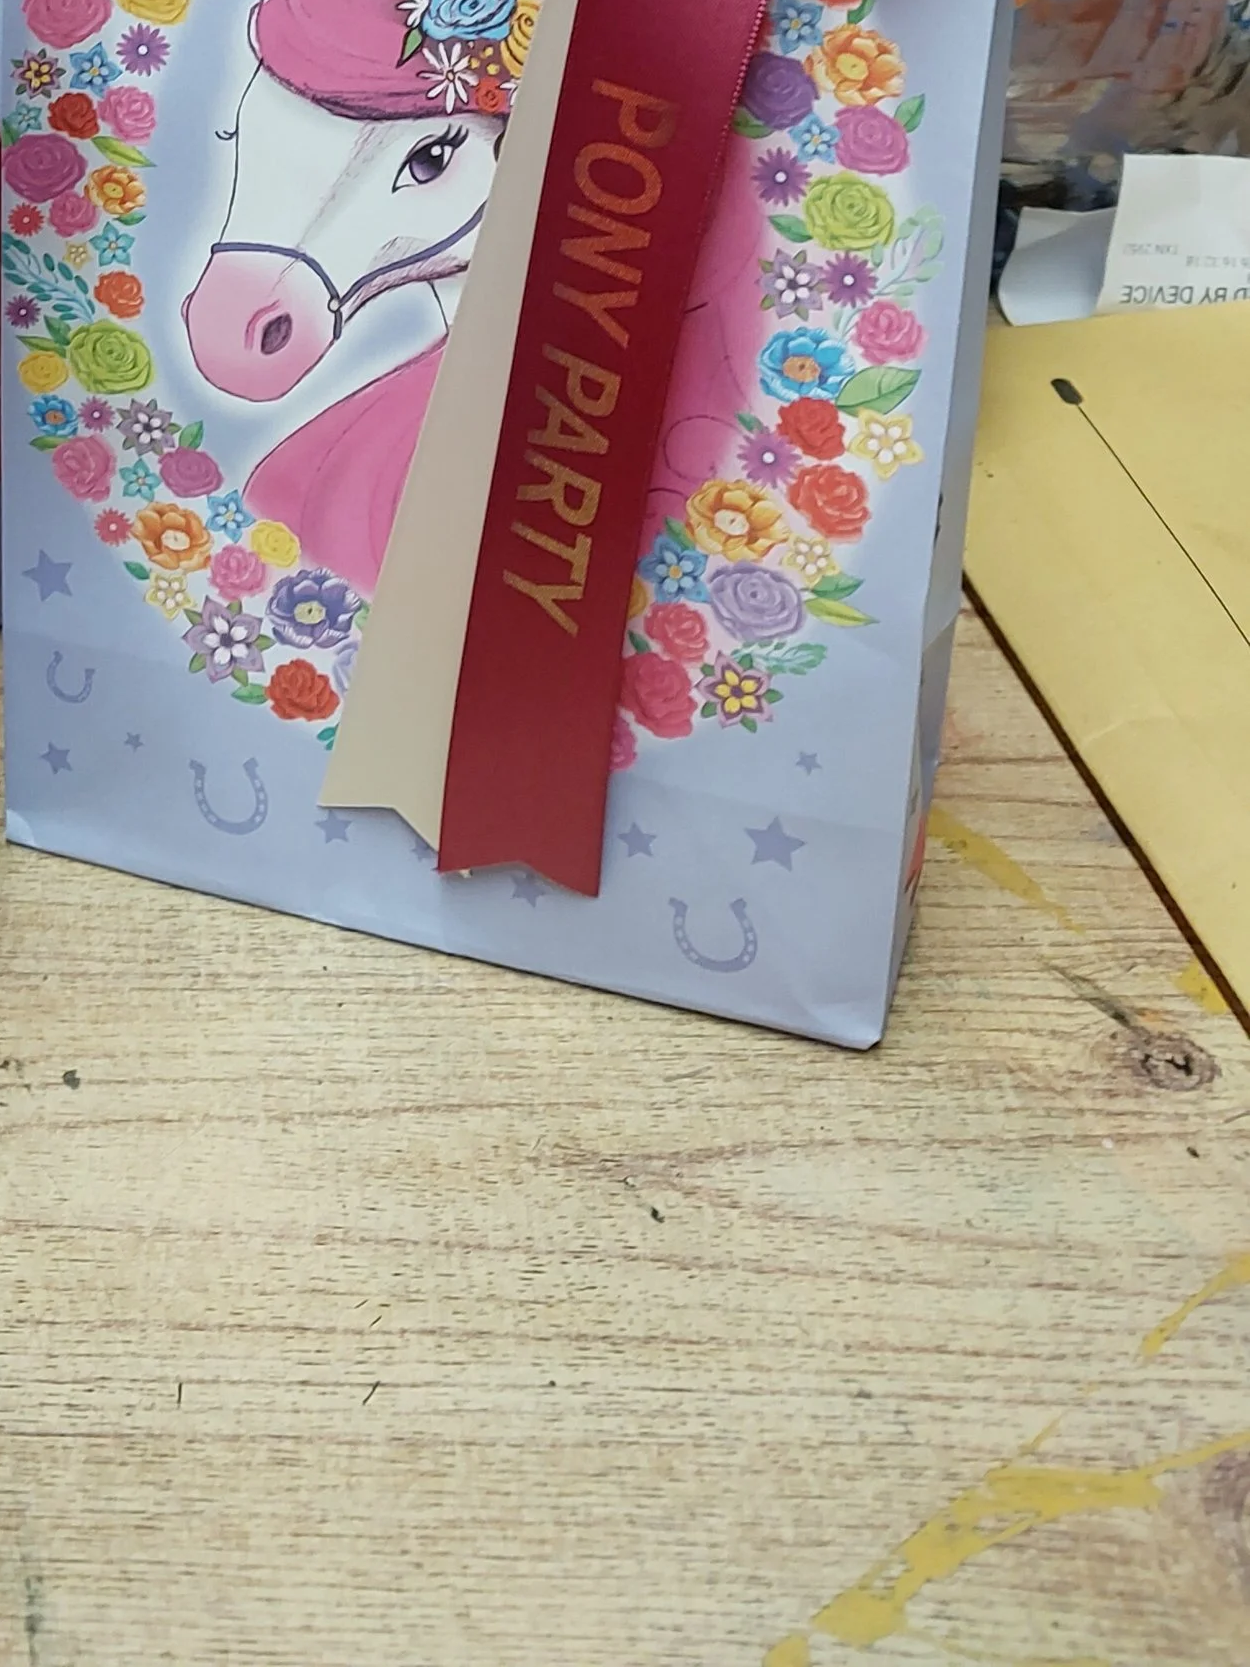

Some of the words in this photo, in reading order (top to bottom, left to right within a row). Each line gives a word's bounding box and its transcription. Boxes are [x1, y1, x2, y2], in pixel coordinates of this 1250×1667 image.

[552, 77, 681, 349] PONY
[1119, 285, 1194, 305] DEVICE
[1198, 286, 1228, 305] BY
[502, 342, 623, 637] PARTY
